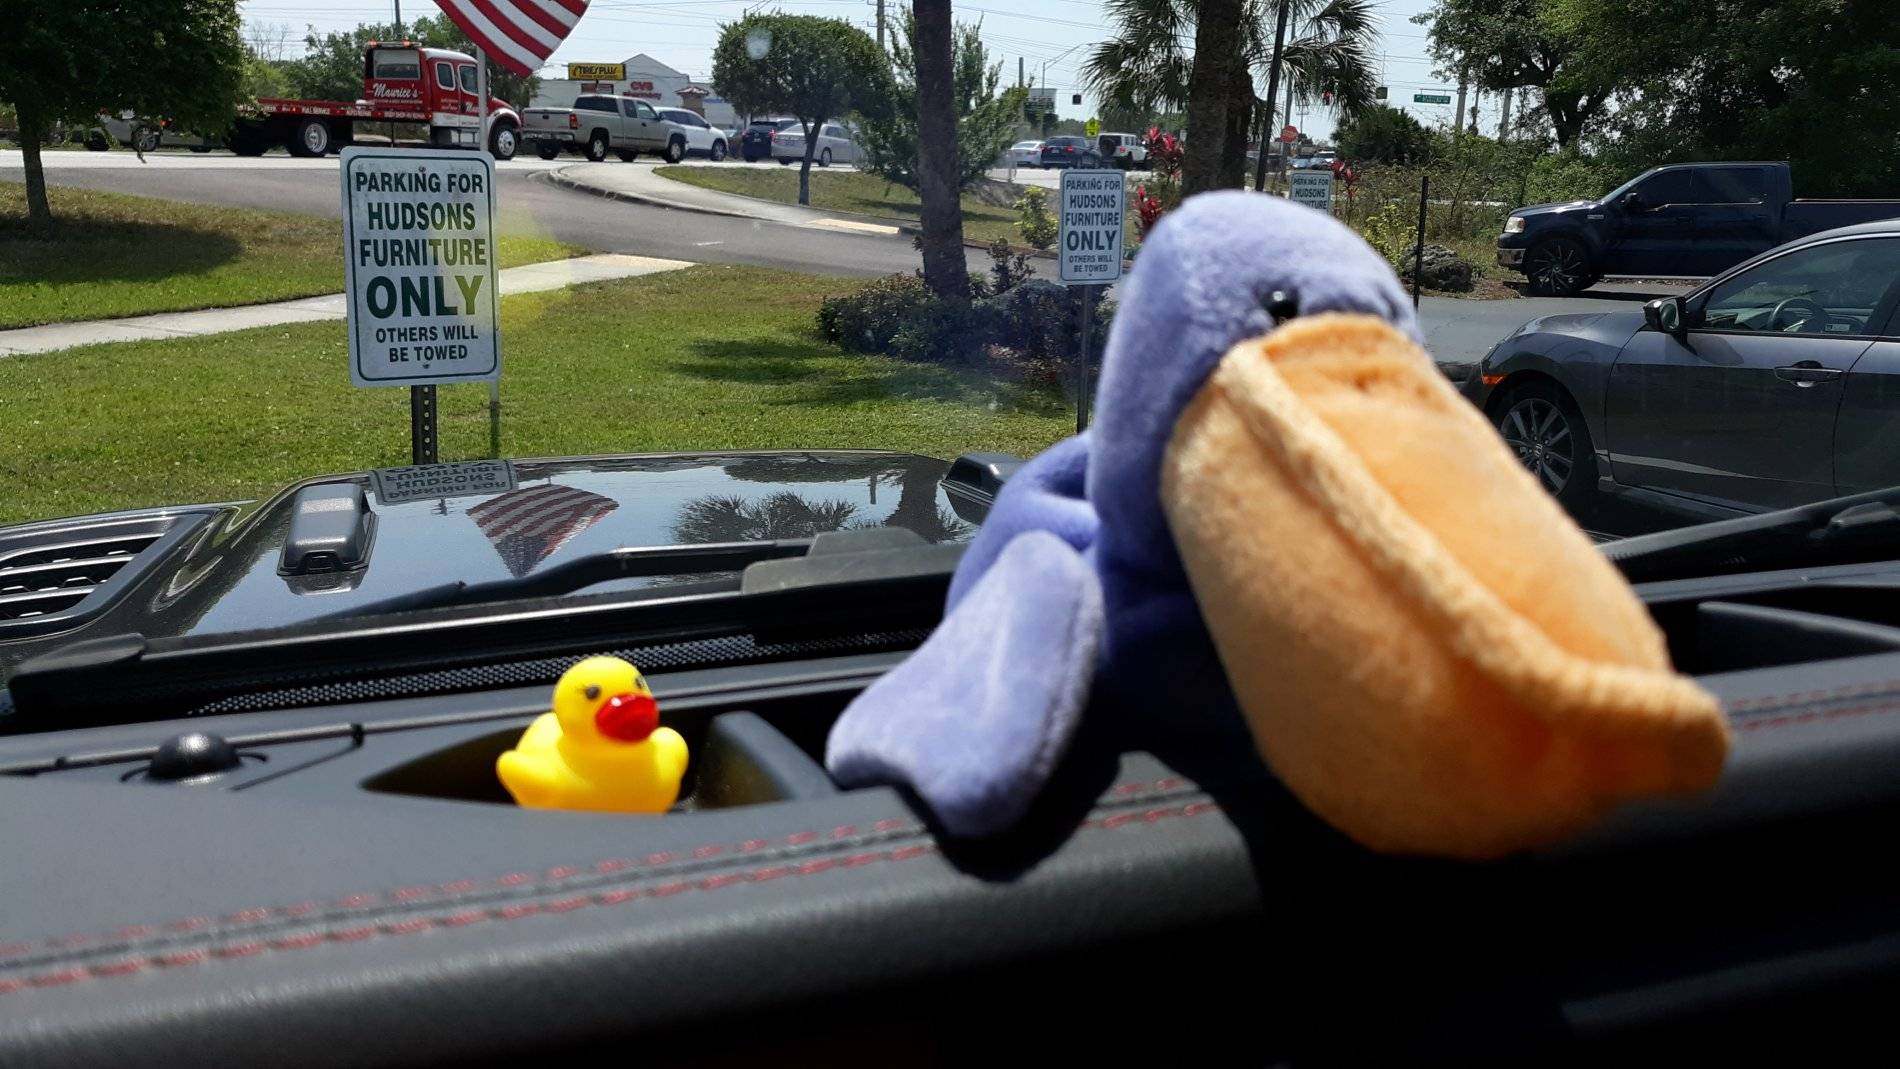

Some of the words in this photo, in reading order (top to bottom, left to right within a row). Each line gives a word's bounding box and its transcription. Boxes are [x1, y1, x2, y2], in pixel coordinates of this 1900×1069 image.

[578, 66, 598, 74] TIRES
[599, 66, 618, 74] PLUS
[372, 82, 418, 98] Maurice's
[630, 81, 654, 90] CVS
[356, 172, 441, 193] PARKING
[448, 173, 484, 193] FOR
[1066, 180, 1102, 190] PARKING
[1104, 180, 1120, 190] FOR
[1295, 188, 1326, 198] HUDSONS
[1070, 194, 1116, 209] HUDSONS
[368, 202, 476, 230] HUDSONS
[1064, 212, 1120, 226] FURNITURE
[1066, 230, 1117, 251] ONLY
[360, 238, 487, 267] FURNITURE
[366, 275, 484, 320] ONLY
[376, 326, 438, 343] OTHERS
[442, 325, 478, 341] WILL
[389, 347, 409, 362] BE
[414, 345, 468, 361] TOWED
